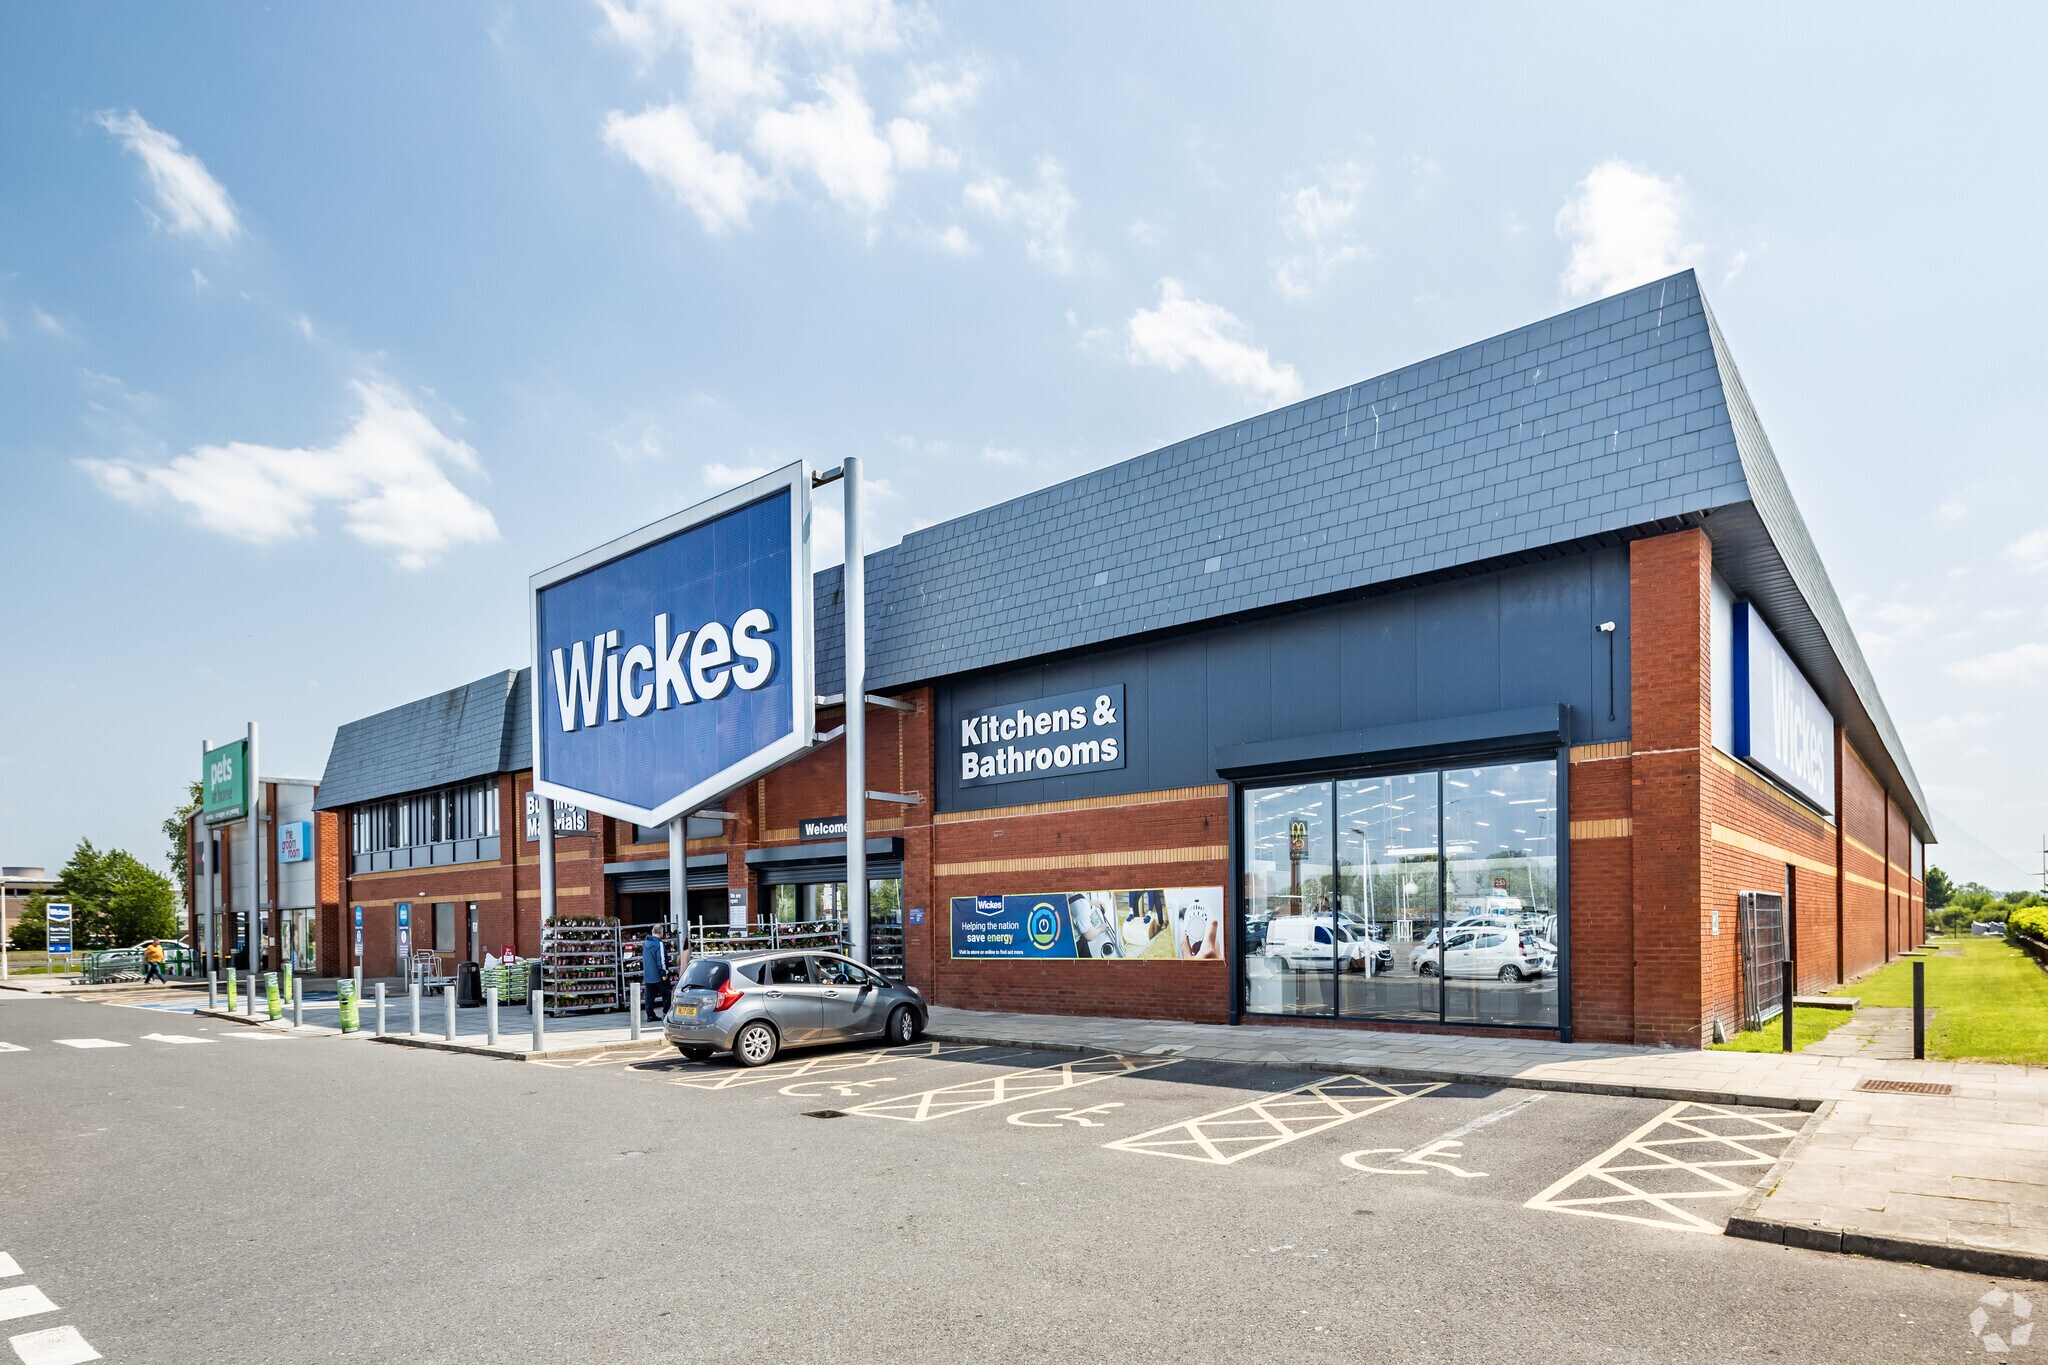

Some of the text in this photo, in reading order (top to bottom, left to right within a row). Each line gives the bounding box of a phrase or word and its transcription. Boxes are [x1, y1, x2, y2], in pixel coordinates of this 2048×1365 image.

[551, 608, 776, 732] Wickes
[961, 694, 1118, 747] Kitchens &
[1770, 647, 1825, 796] Wickes
[962, 738, 1119, 780] Bathrooms
[211, 754, 232, 791] pets
[211, 786, 233, 804] at home
[285, 828, 294, 840] the
[282, 840, 296, 854] groom
[288, 849, 300, 859] room
[978, 900, 1002, 910] Wickes
[961, 921, 1019, 932] Helping the nation
[967, 934, 1014, 945] save energy
